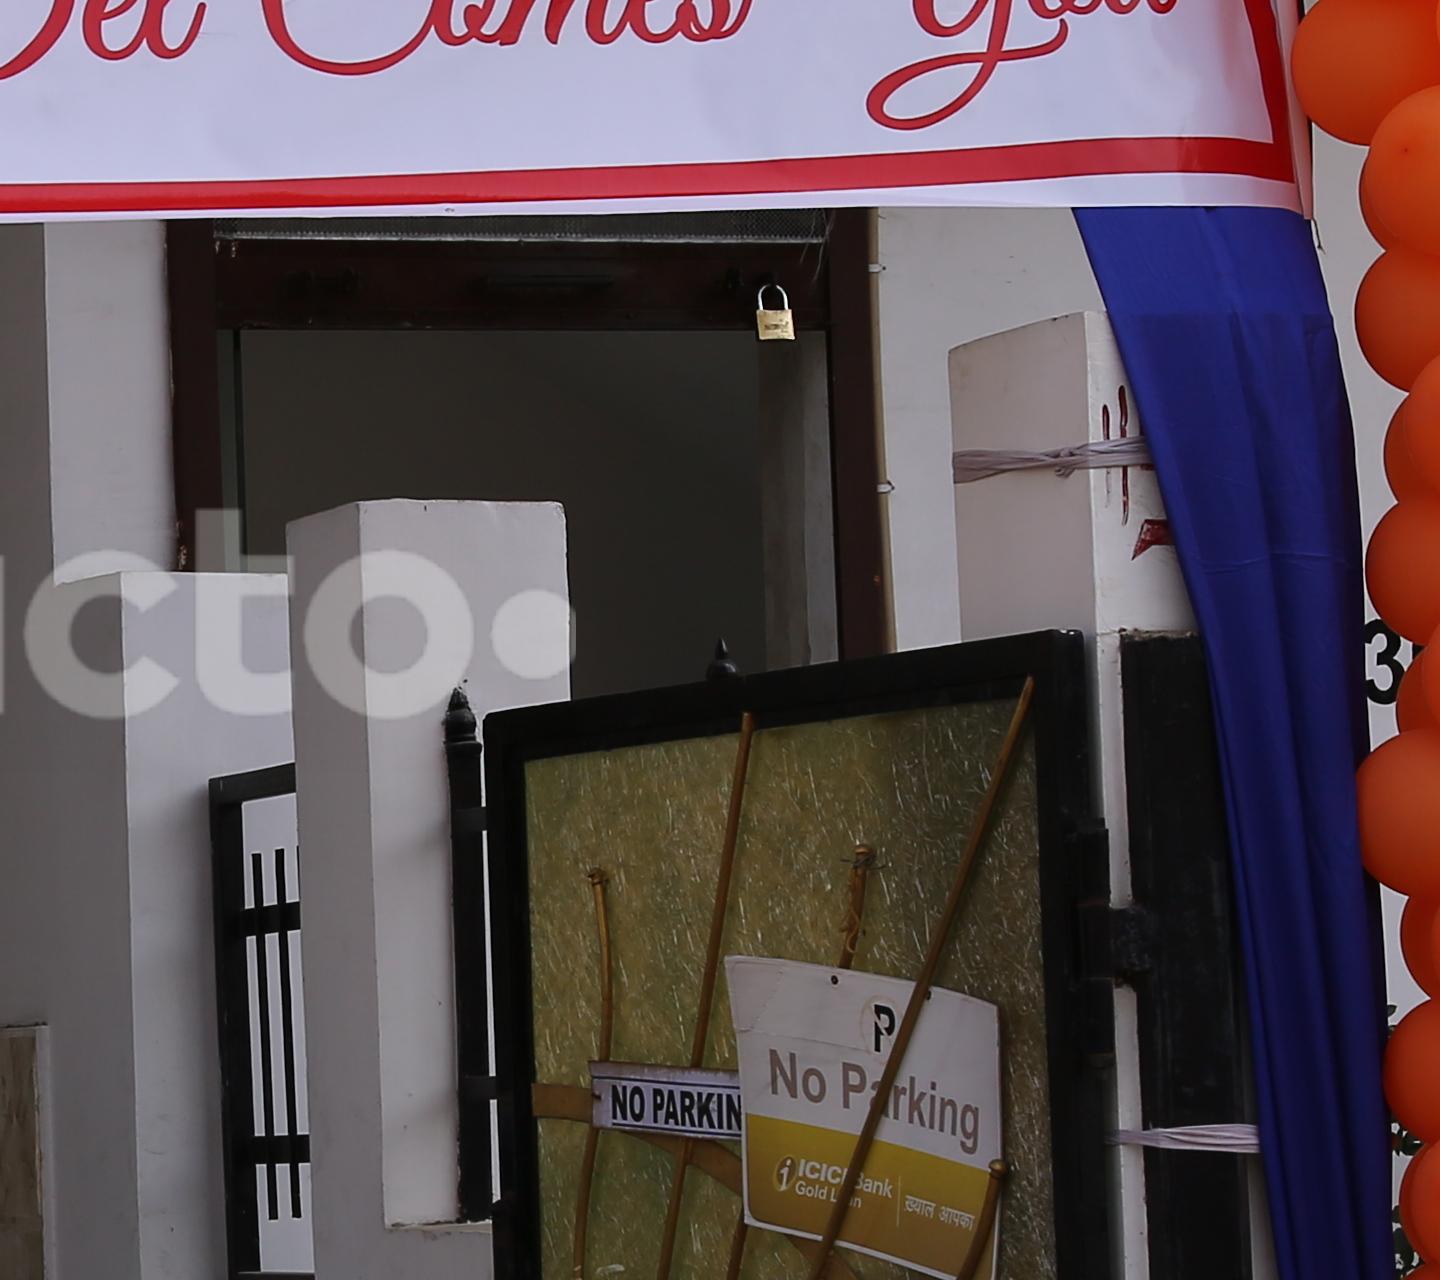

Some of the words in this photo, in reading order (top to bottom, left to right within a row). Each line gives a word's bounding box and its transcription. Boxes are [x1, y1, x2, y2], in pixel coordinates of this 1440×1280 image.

[769, 1048, 827, 1104] No
[610, 1083, 646, 1123] NO
[794, 1180, 828, 1200] Gold
[829, 1187, 863, 1208] Ln
